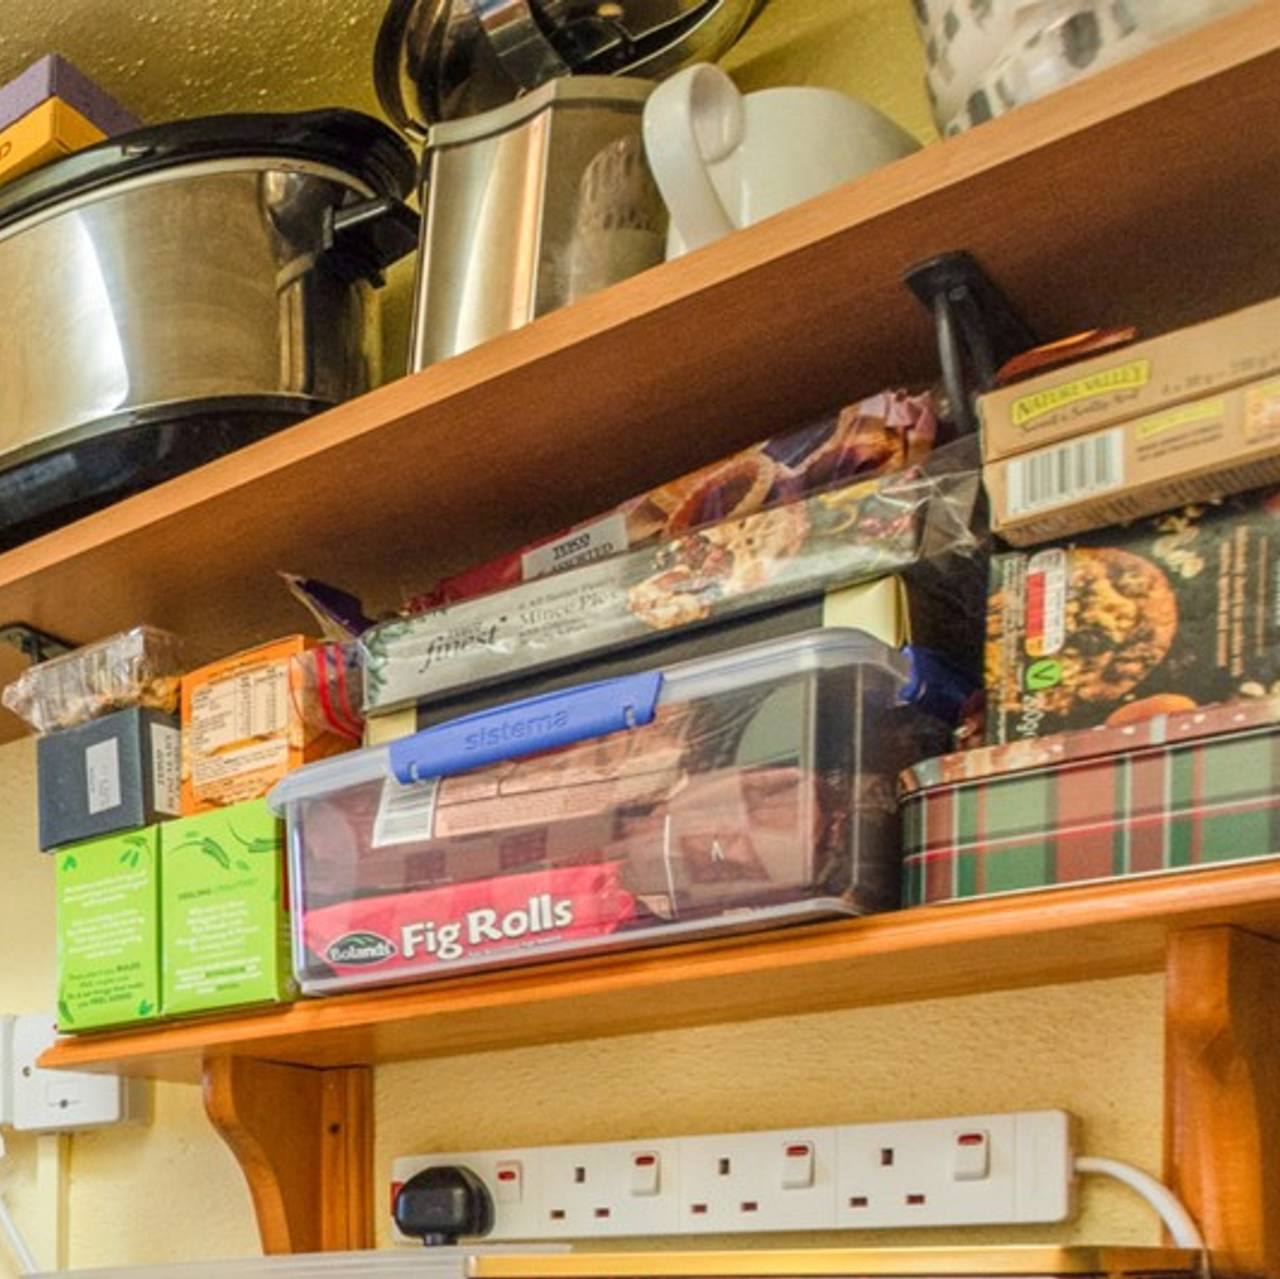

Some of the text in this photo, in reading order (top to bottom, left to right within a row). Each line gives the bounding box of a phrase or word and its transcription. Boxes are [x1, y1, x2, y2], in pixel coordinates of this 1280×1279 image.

[465, 710, 569, 751] sistema
[401, 922, 463, 960] Fig
[467, 894, 573, 944] Rolls
[330, 941, 391, 962] Bolands
